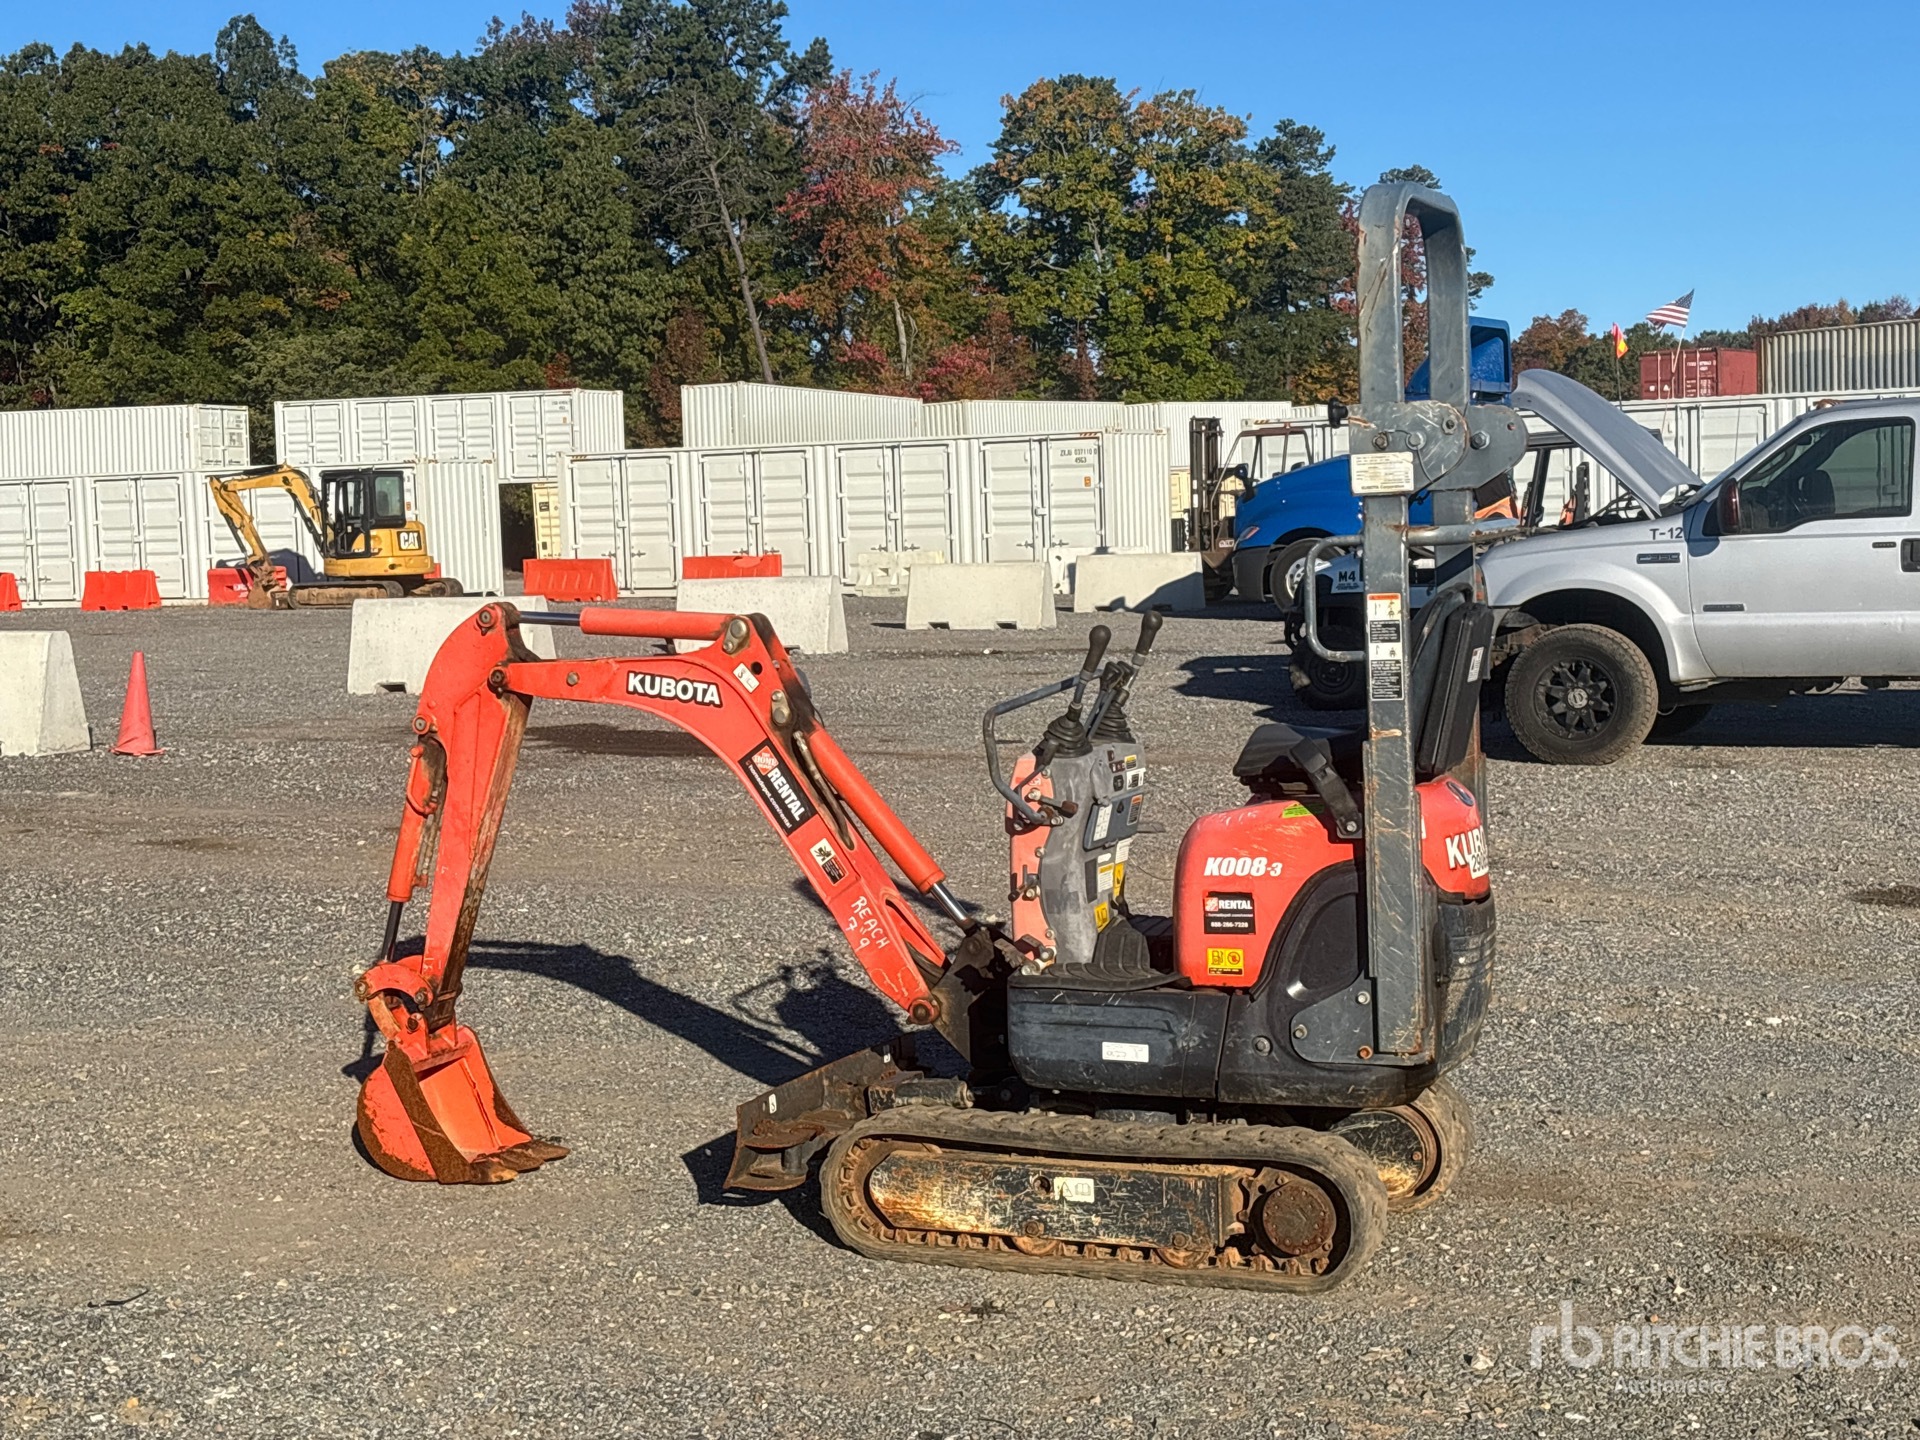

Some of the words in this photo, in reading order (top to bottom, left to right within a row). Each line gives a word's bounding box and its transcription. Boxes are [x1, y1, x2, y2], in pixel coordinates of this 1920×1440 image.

[400, 531, 419, 550] CAT
[1649, 527, 1683, 540] T-12
[627, 672, 721, 705] KUBOTA
[767, 767, 805, 822] RENTAL
[1203, 857, 1283, 877] K008-3
[1218, 899, 1253, 910] RENTAL
[851, 896, 890, 949] REACH
